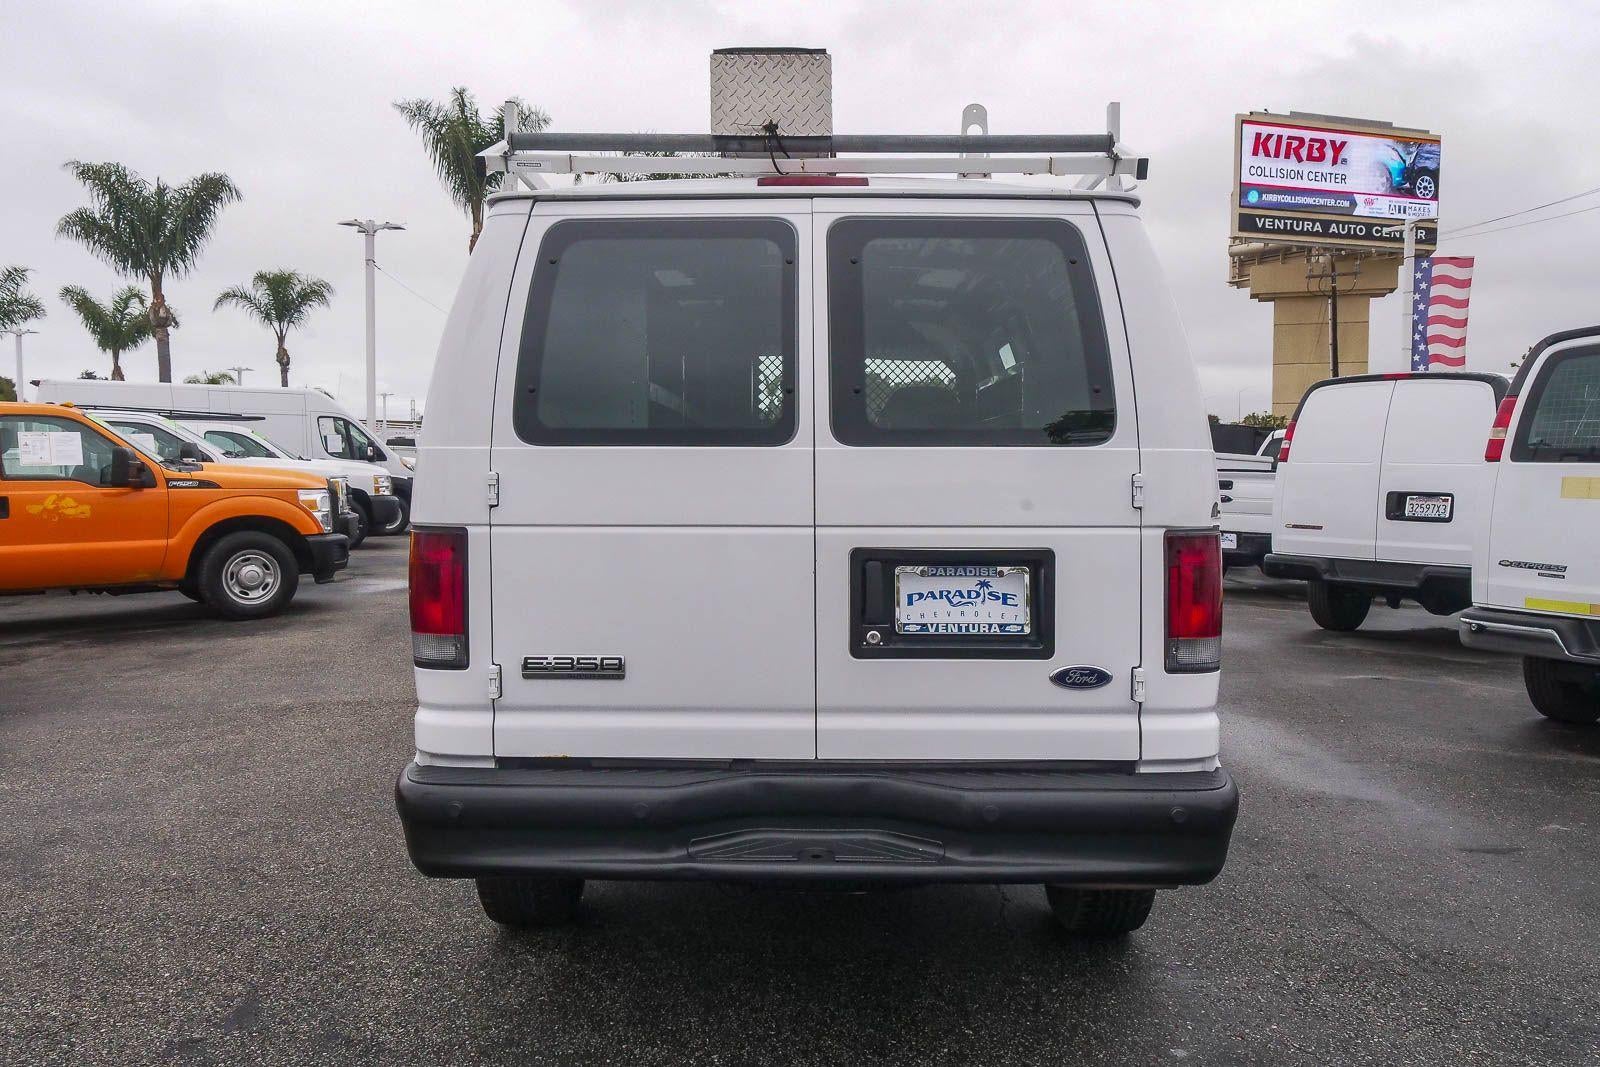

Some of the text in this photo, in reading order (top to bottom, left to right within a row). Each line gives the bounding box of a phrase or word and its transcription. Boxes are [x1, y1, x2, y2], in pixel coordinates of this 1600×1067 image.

[1252, 132, 1347, 166] KIRBY
[1248, 165, 1347, 185] COLLISION CENTER
[1262, 193, 1350, 208] KIRBYCOLLISIONCENTER.COM
[1407, 205, 1431, 214] MAKES
[1255, 217, 1323, 233] VENTURA
[1328, 222, 1366, 236] AUTO
[1408, 503, 1447, 514] 32597X3
[928, 567, 998, 577] PARADISE
[1511, 561, 1567, 573] EXPRESS
[906, 579, 1019, 608] PARADISE
[927, 623, 1001, 633] VENTURA
[522, 656, 623, 671] E-350
[1065, 669, 1098, 683] Ford
